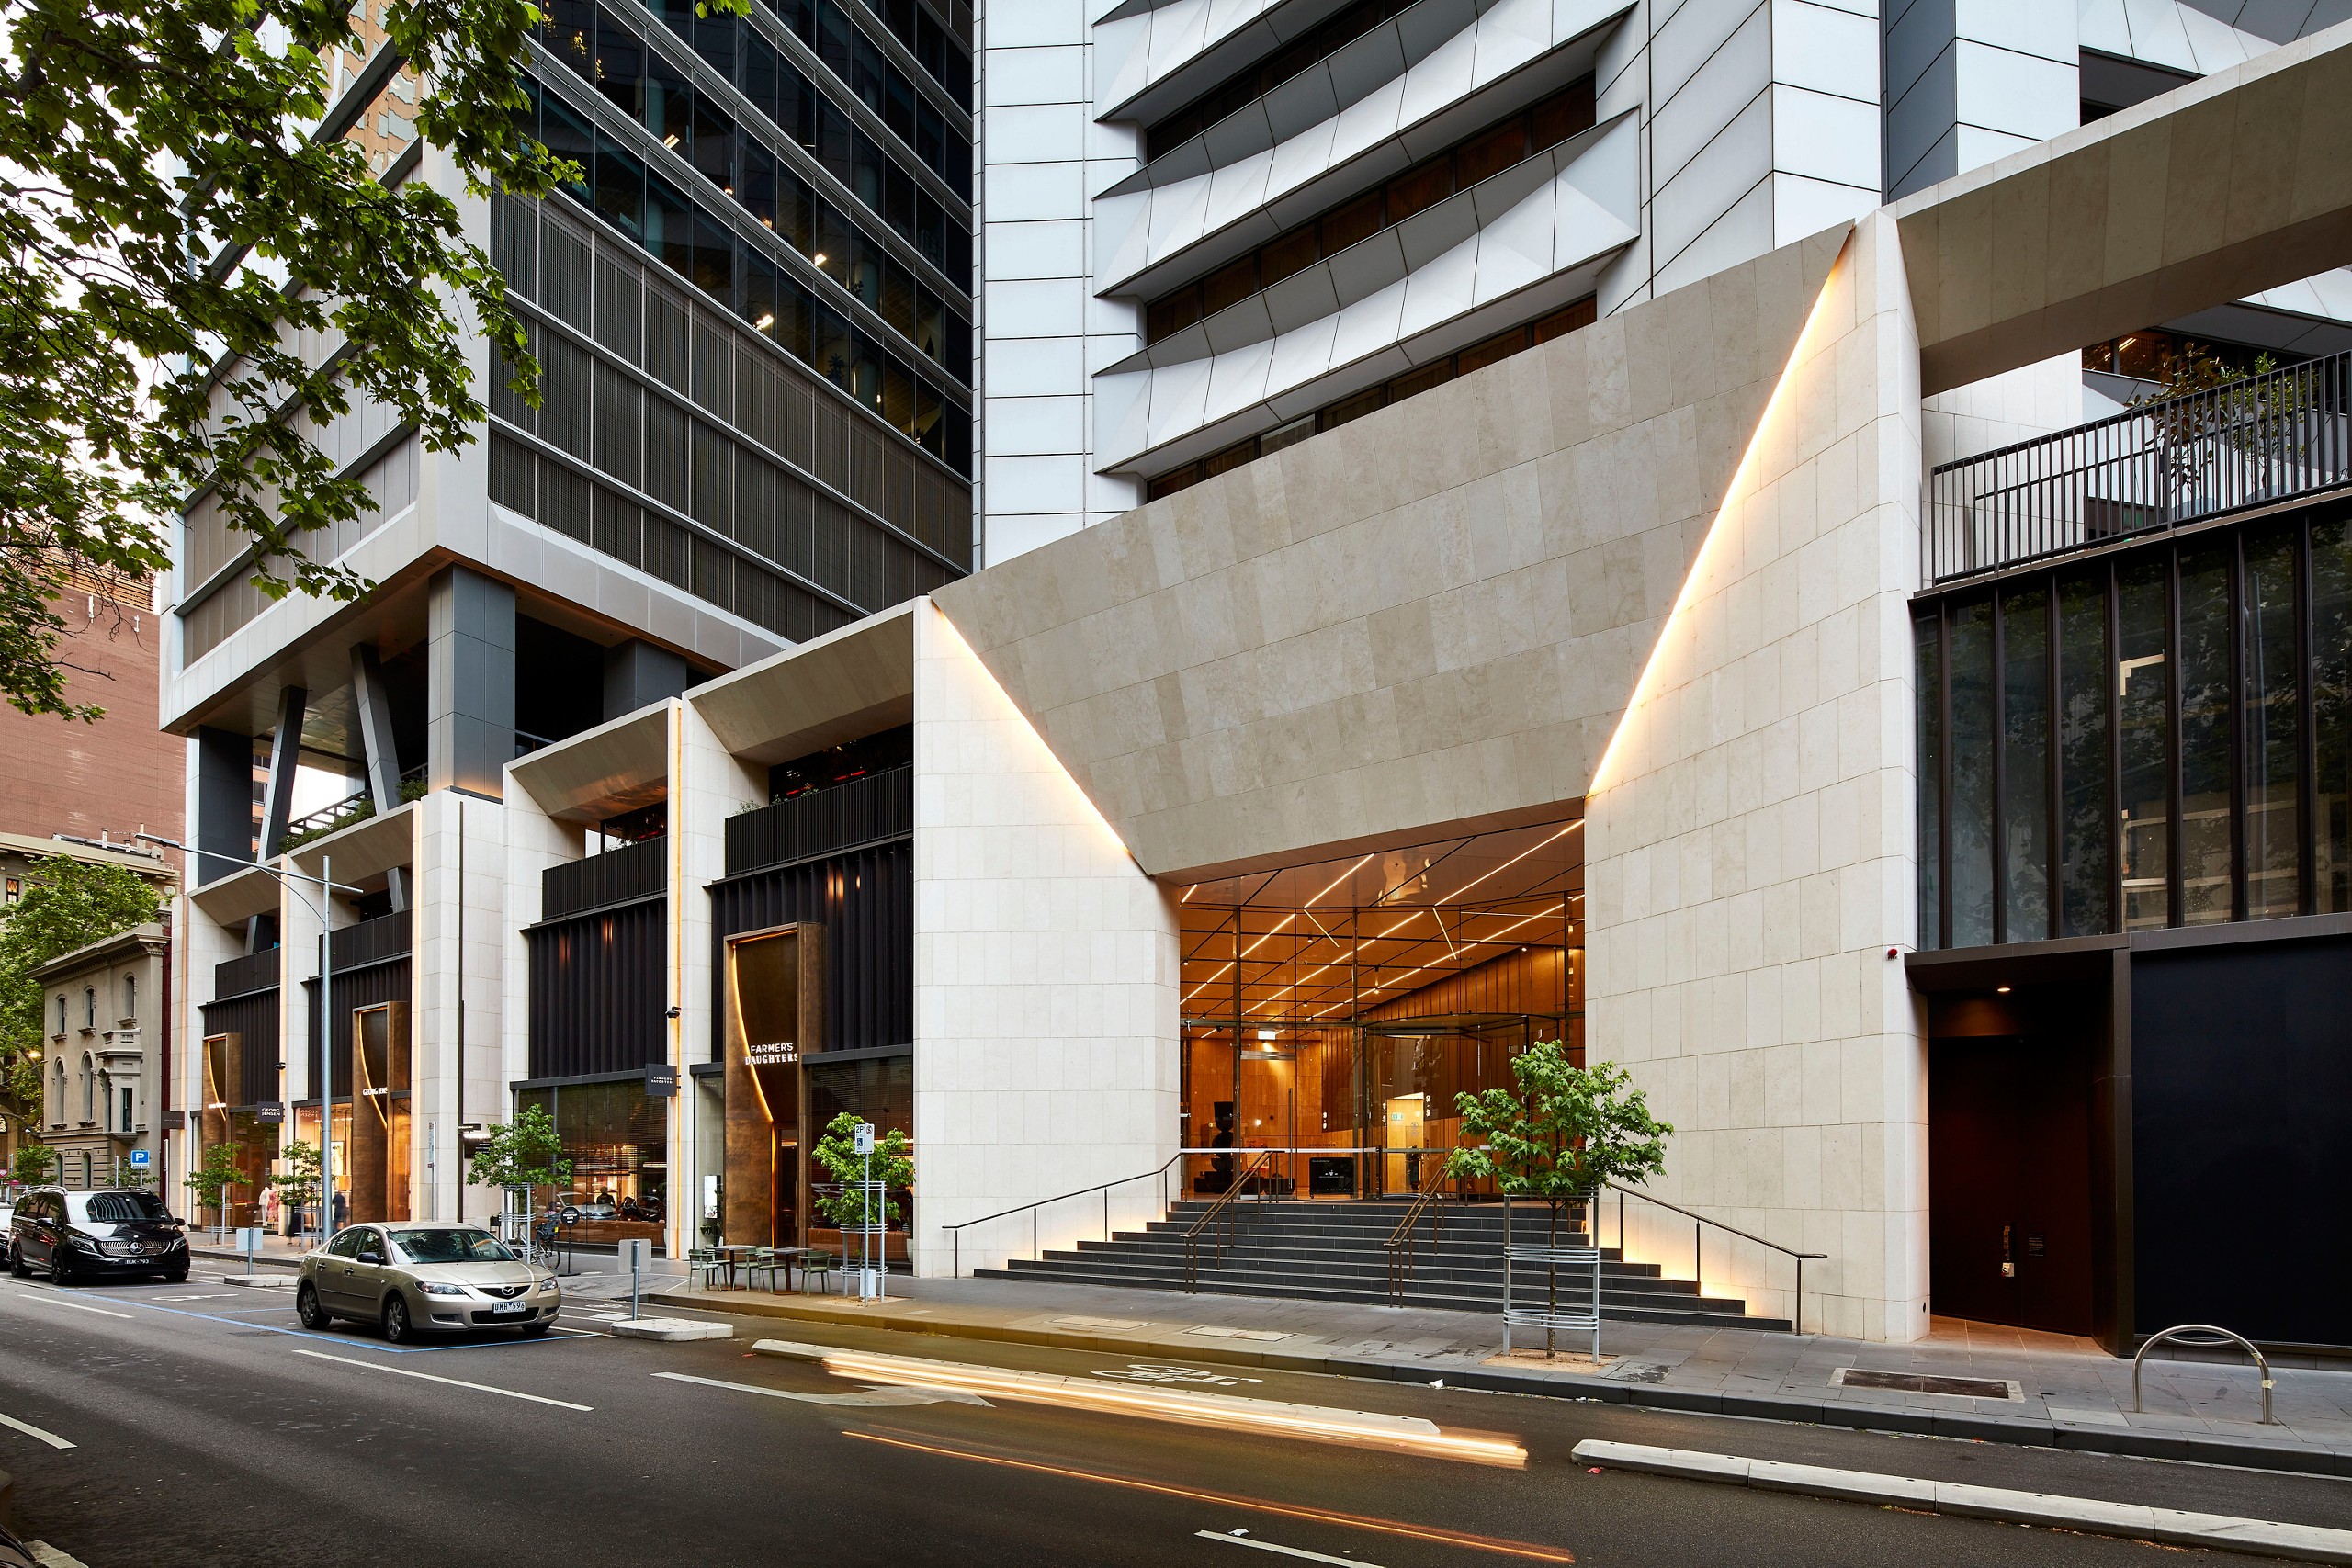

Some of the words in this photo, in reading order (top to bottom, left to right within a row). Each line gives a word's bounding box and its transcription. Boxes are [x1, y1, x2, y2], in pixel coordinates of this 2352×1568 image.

[744, 1053, 798, 1066] DAUGHTERS
[855, 1125, 864, 1134] 2P
[135, 1153, 144, 1162] P
[494, 1303, 508, 1311] UMH
[513, 1302, 525, 1310] 596
